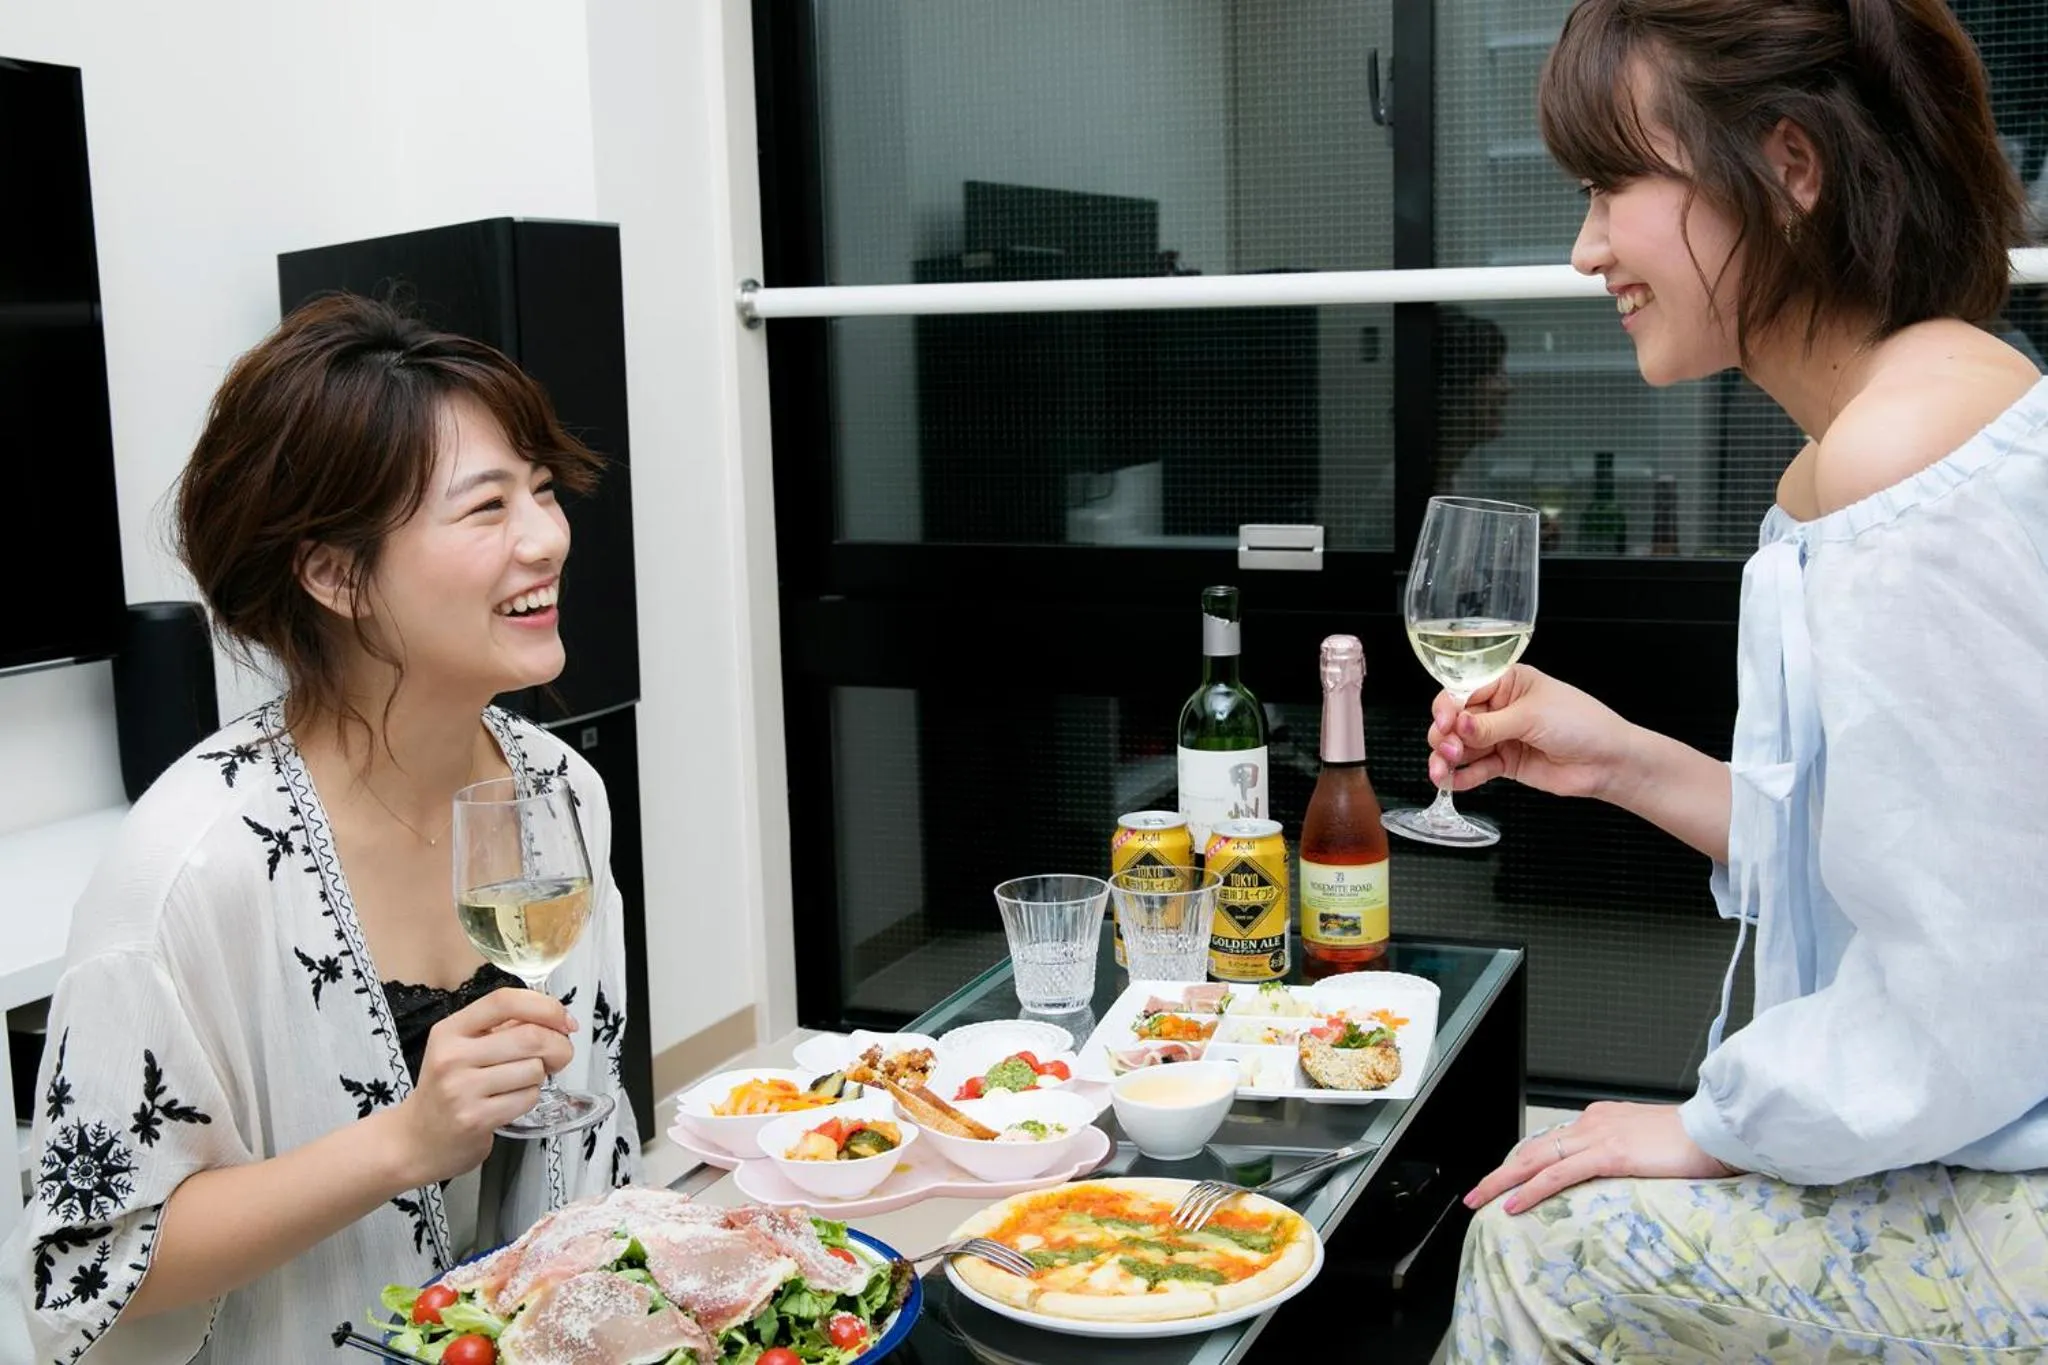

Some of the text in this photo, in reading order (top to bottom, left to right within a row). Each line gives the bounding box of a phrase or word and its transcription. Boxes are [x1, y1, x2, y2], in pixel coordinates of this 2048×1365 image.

[1230, 873, 1259, 887] TOKYO
[1211, 935, 1281, 950] GOLDEN ALE
